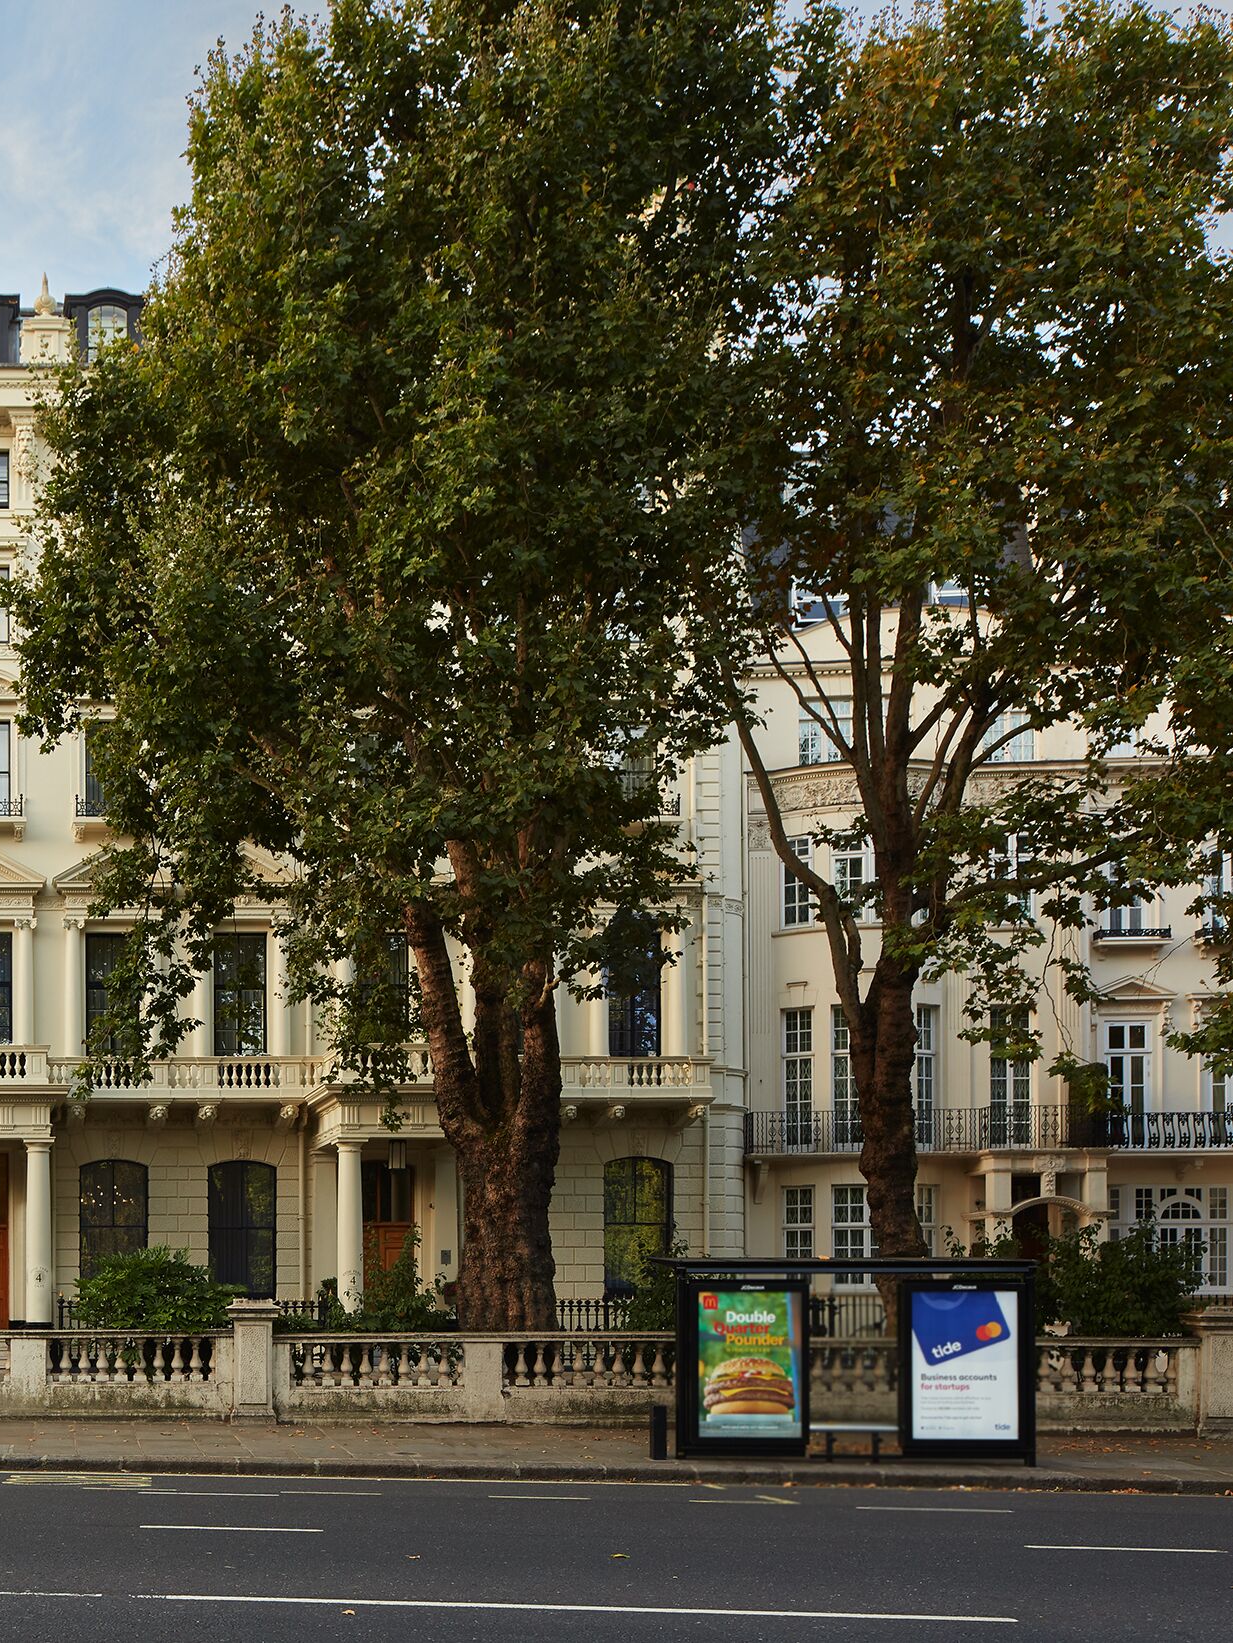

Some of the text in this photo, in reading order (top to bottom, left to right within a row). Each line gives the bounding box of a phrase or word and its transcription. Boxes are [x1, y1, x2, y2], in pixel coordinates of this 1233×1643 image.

[35, 1273, 42, 1283] 4
[350, 1276, 356, 1285] 4
[726, 1311, 776, 1323] Double
[713, 1322, 770, 1335] Quarter
[726, 1334, 784, 1345] Pounder
[932, 1341, 962, 1359] tide
[920, 1373, 957, 1381] Business
[935, 1383, 970, 1391] startups
